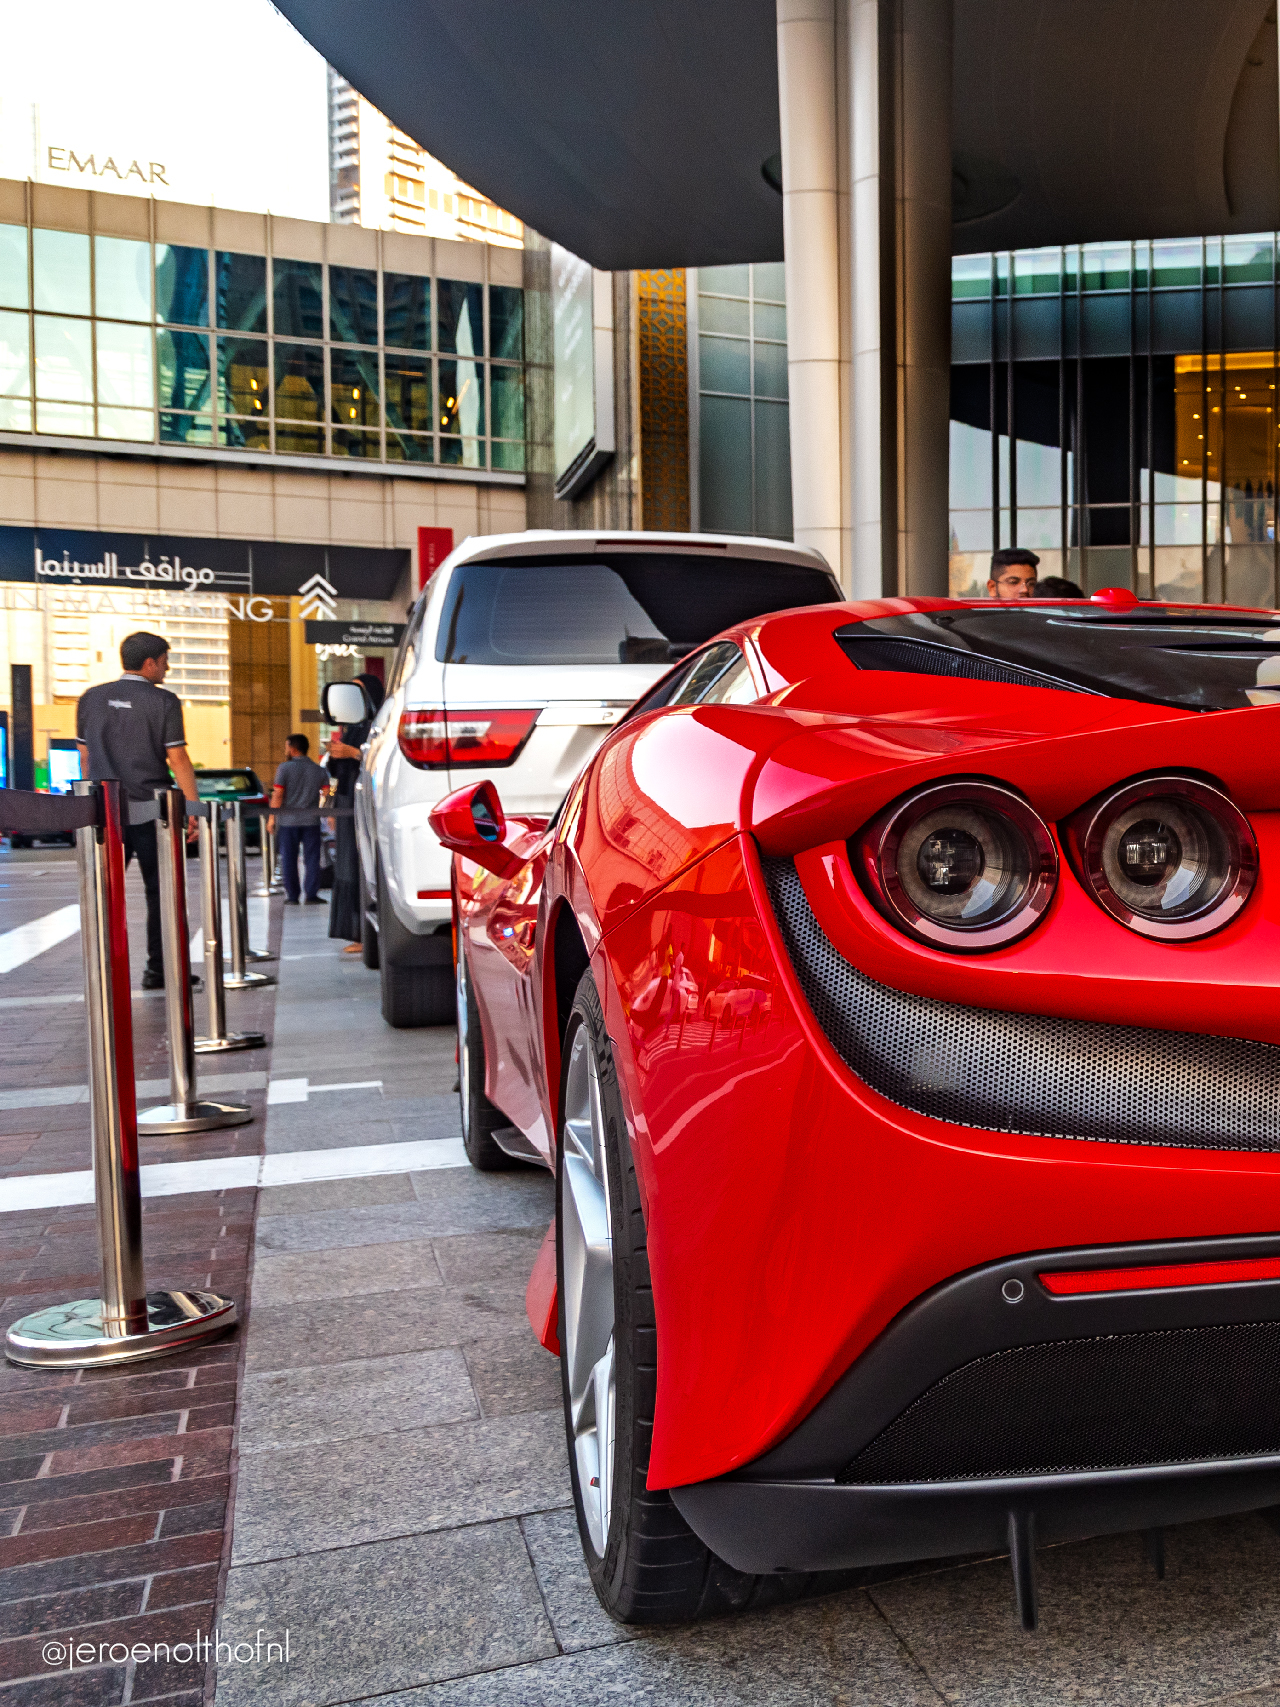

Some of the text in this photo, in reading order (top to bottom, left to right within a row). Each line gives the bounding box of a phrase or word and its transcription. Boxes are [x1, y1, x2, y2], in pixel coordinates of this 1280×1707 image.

[48, 146, 169, 186] EMAAR
[35, 548, 214, 592] مواقف السينما
